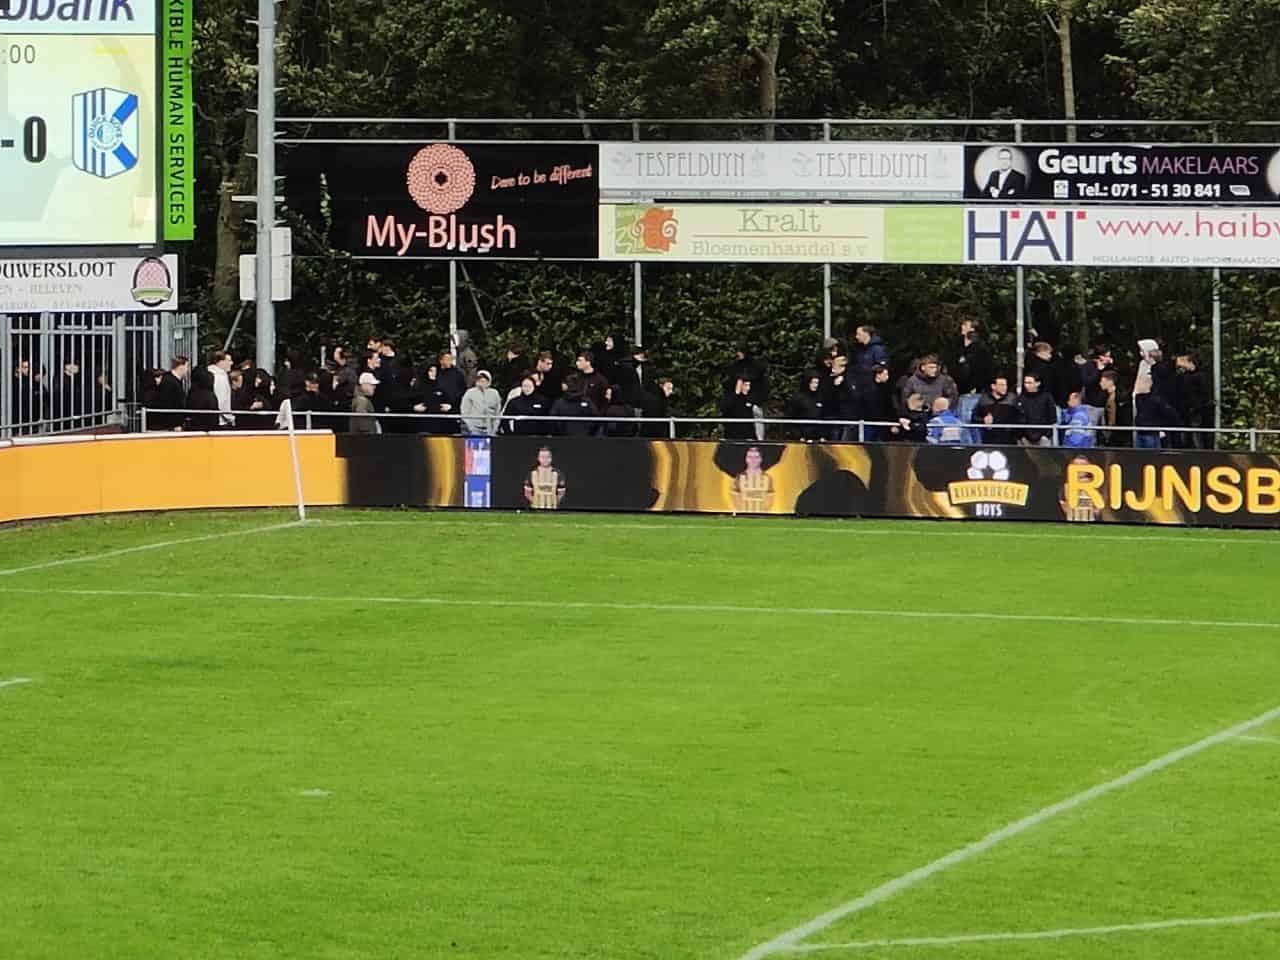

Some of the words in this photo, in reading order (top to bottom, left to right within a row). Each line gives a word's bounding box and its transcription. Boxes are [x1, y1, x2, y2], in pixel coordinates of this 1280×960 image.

[168, 56, 184, 126] HUMAN
[518, 171, 531, 185] to
[534, 169, 547, 184] be
[549, 163, 592, 185] different
[635, 151, 746, 178] TESPELDUYN
[816, 151, 929, 178] TESPELDUYN
[1038, 148, 1138, 174] Geurts
[1141, 155, 1259, 175] MAKELAARS
[169, 133, 185, 225] SERVICES
[1111, 183, 1138, 197] 071
[1151, 183, 1168, 197] 51
[1172, 183, 1191, 197] 30
[1195, 183, 1221, 197] 841
[736, 208, 822, 233] Kralt
[366, 214, 516, 257] My-Blush
[692, 241, 836, 257] Bloemenhandel
[968, 210, 1074, 261] HAI
[1066, 463, 1280, 514] RIJNSB
[975, 504, 1002, 517] BOYS
